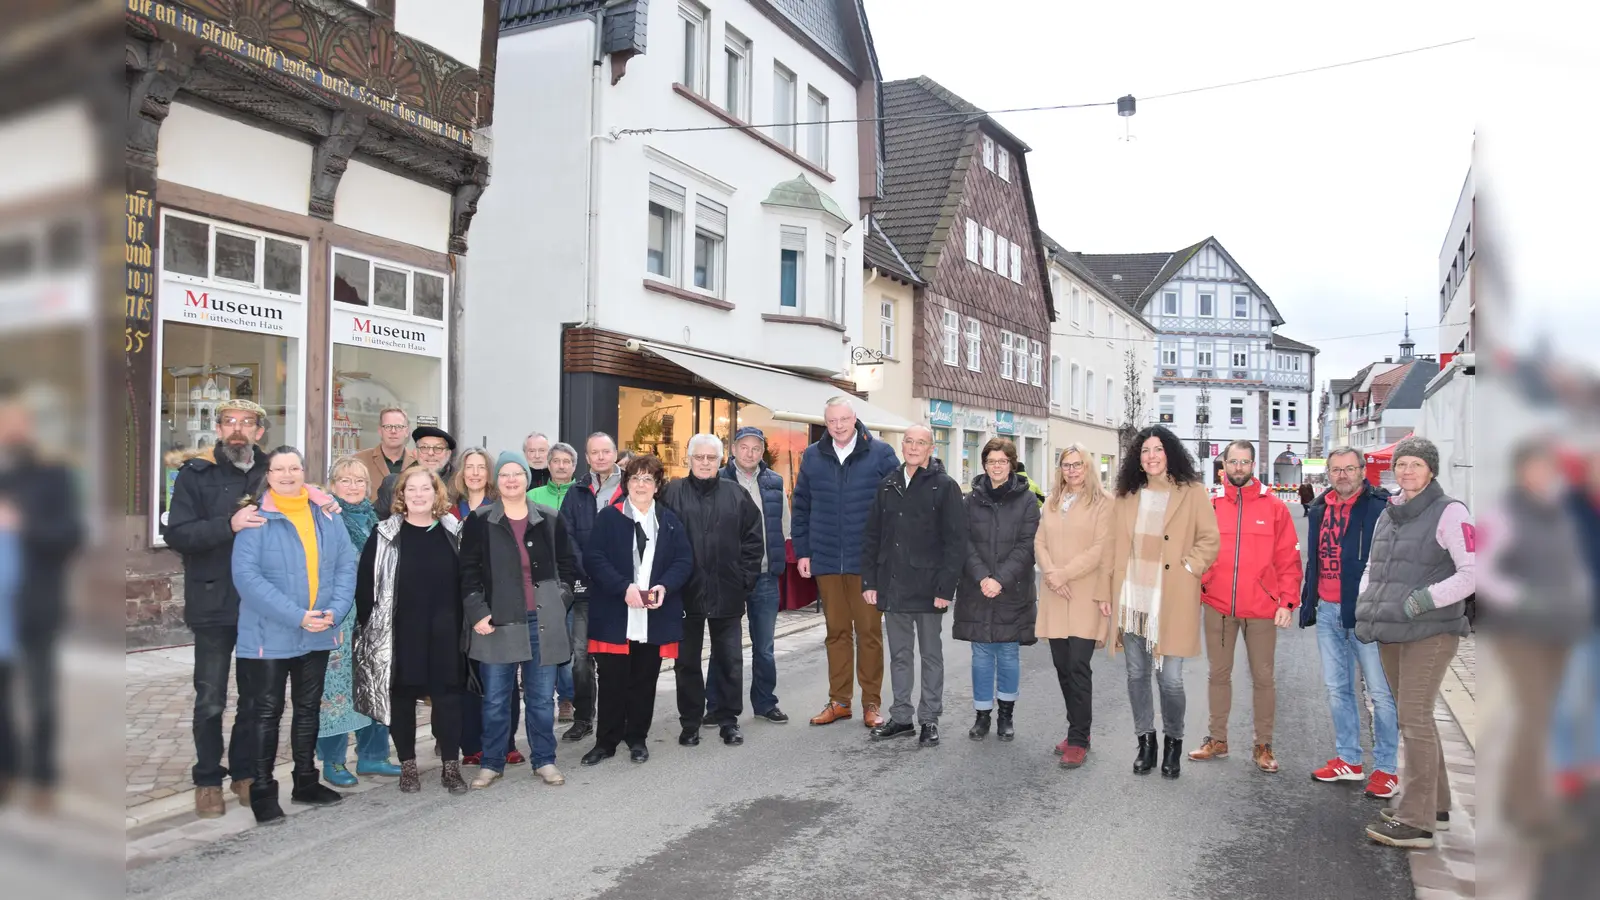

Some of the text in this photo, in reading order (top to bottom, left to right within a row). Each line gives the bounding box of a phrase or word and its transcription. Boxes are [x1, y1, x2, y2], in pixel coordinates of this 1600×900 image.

[184, 289, 284, 321] Museum
[183, 309, 284, 331] im Hütteschen Haus
[353, 316, 427, 343] Museum
[352, 334, 363, 342] im
[408, 342, 427, 352] Haus
